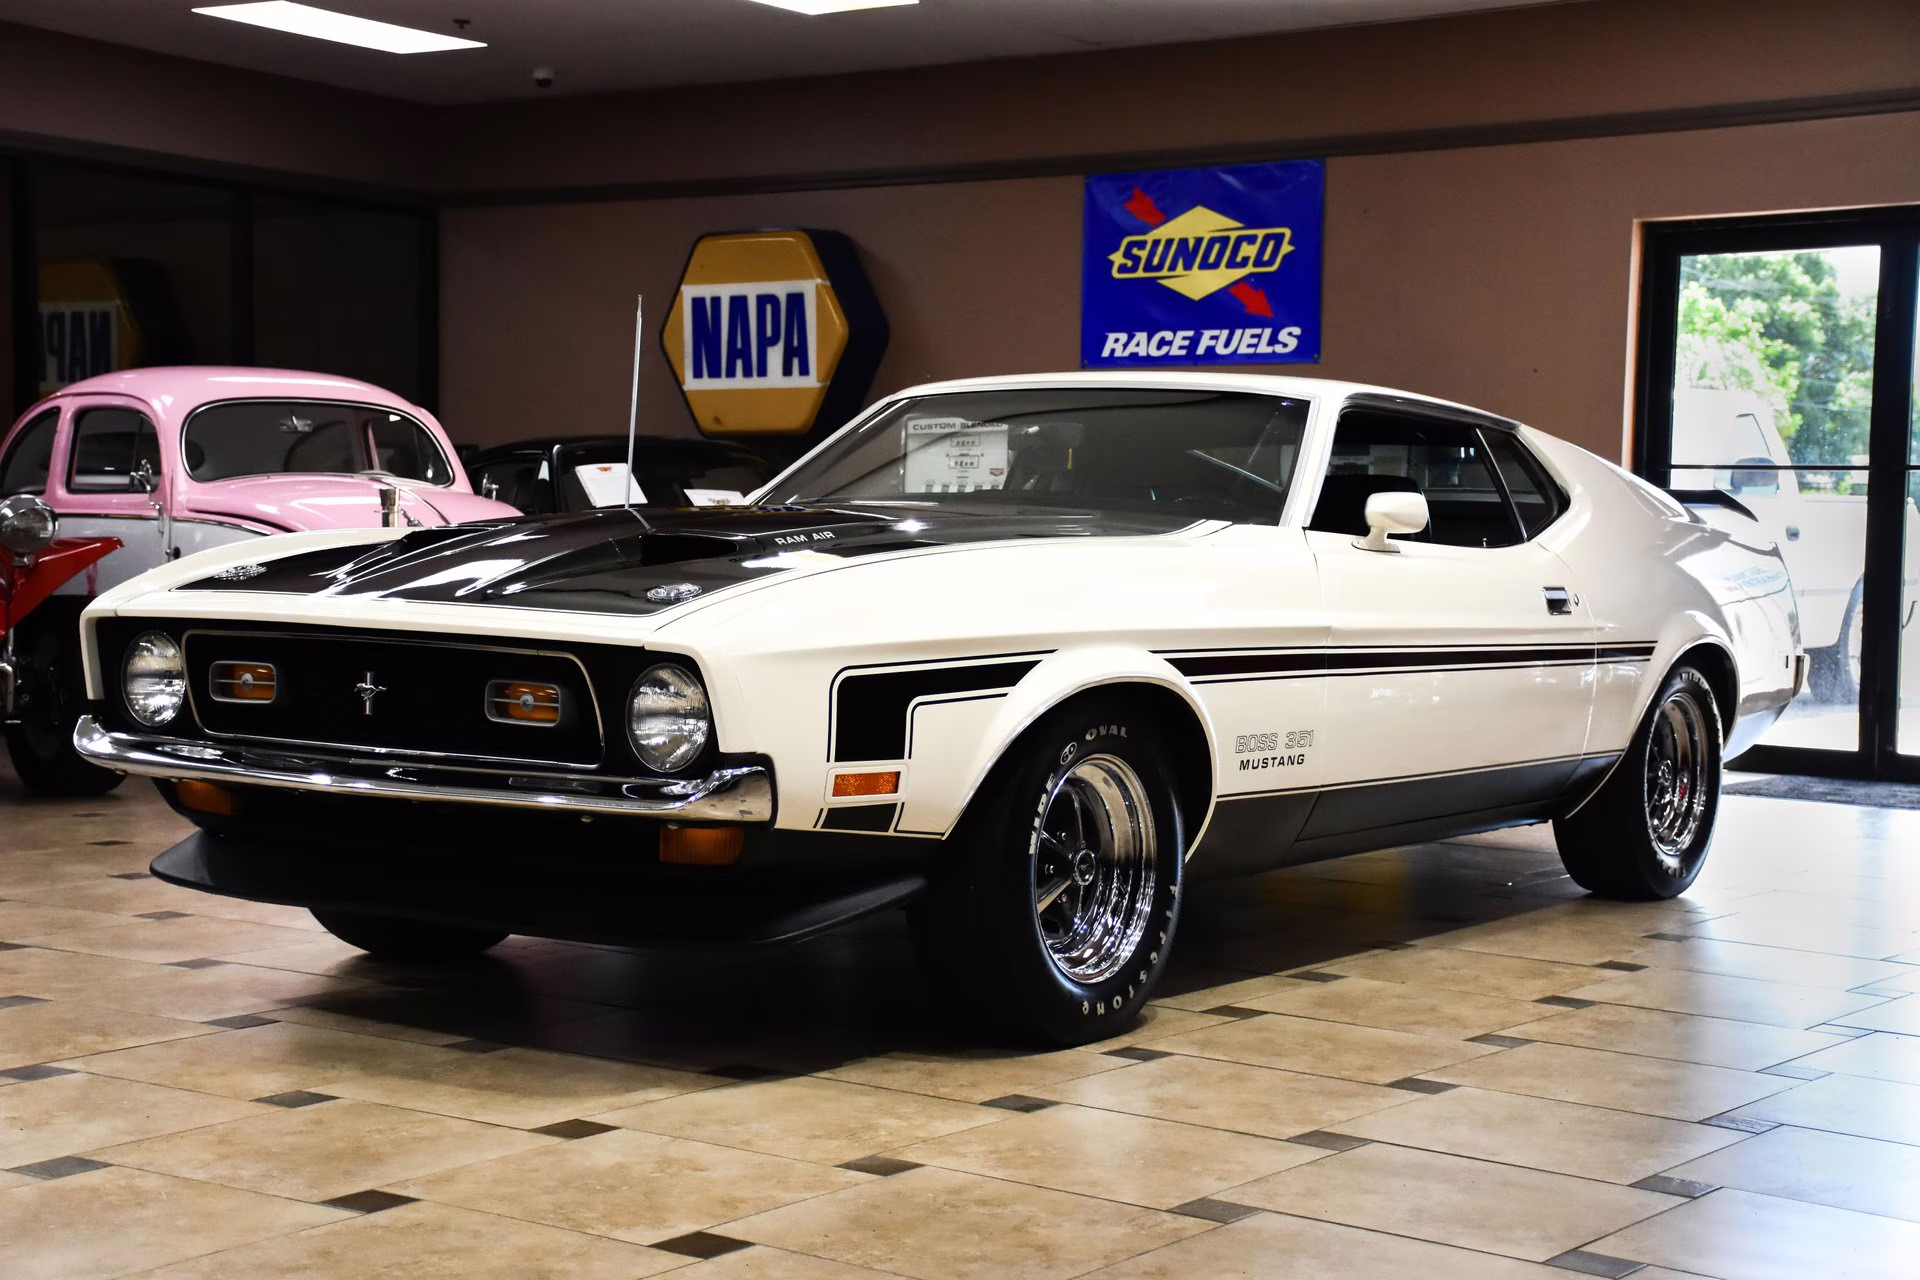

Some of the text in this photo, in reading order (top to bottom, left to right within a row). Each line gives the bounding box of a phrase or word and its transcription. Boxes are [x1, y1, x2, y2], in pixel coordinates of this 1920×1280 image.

[1116, 232, 1286, 274] SUNOCO
[691, 292, 810, 379] NAPA
[1101, 326, 1302, 358] RACE FUELS
[912, 422, 957, 431] CUSTOM
[774, 531, 836, 545] RAM AIR
[1061, 743, 1077, 764] 60
[1085, 724, 1128, 741] OVAL
[1235, 729, 1314, 753] BOSS 351
[1239, 754, 1305, 771] MUSTANG
